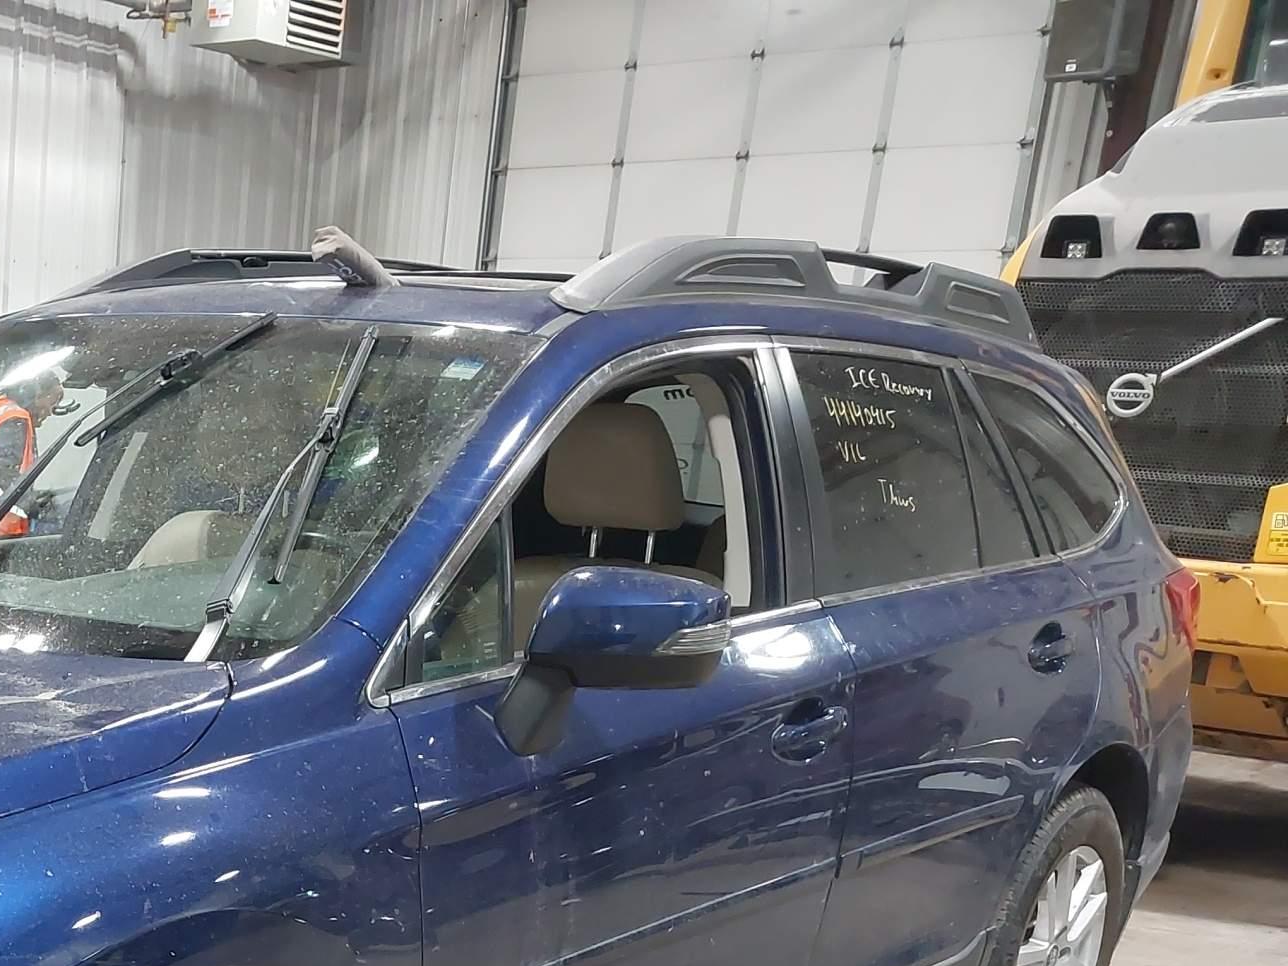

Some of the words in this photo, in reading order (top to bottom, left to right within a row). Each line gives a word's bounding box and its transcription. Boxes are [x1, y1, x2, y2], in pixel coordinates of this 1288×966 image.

[845, 366, 880, 388] ICE
[1110, 391, 1151, 399] VOLVO
[824, 396, 896, 429] 44140415
